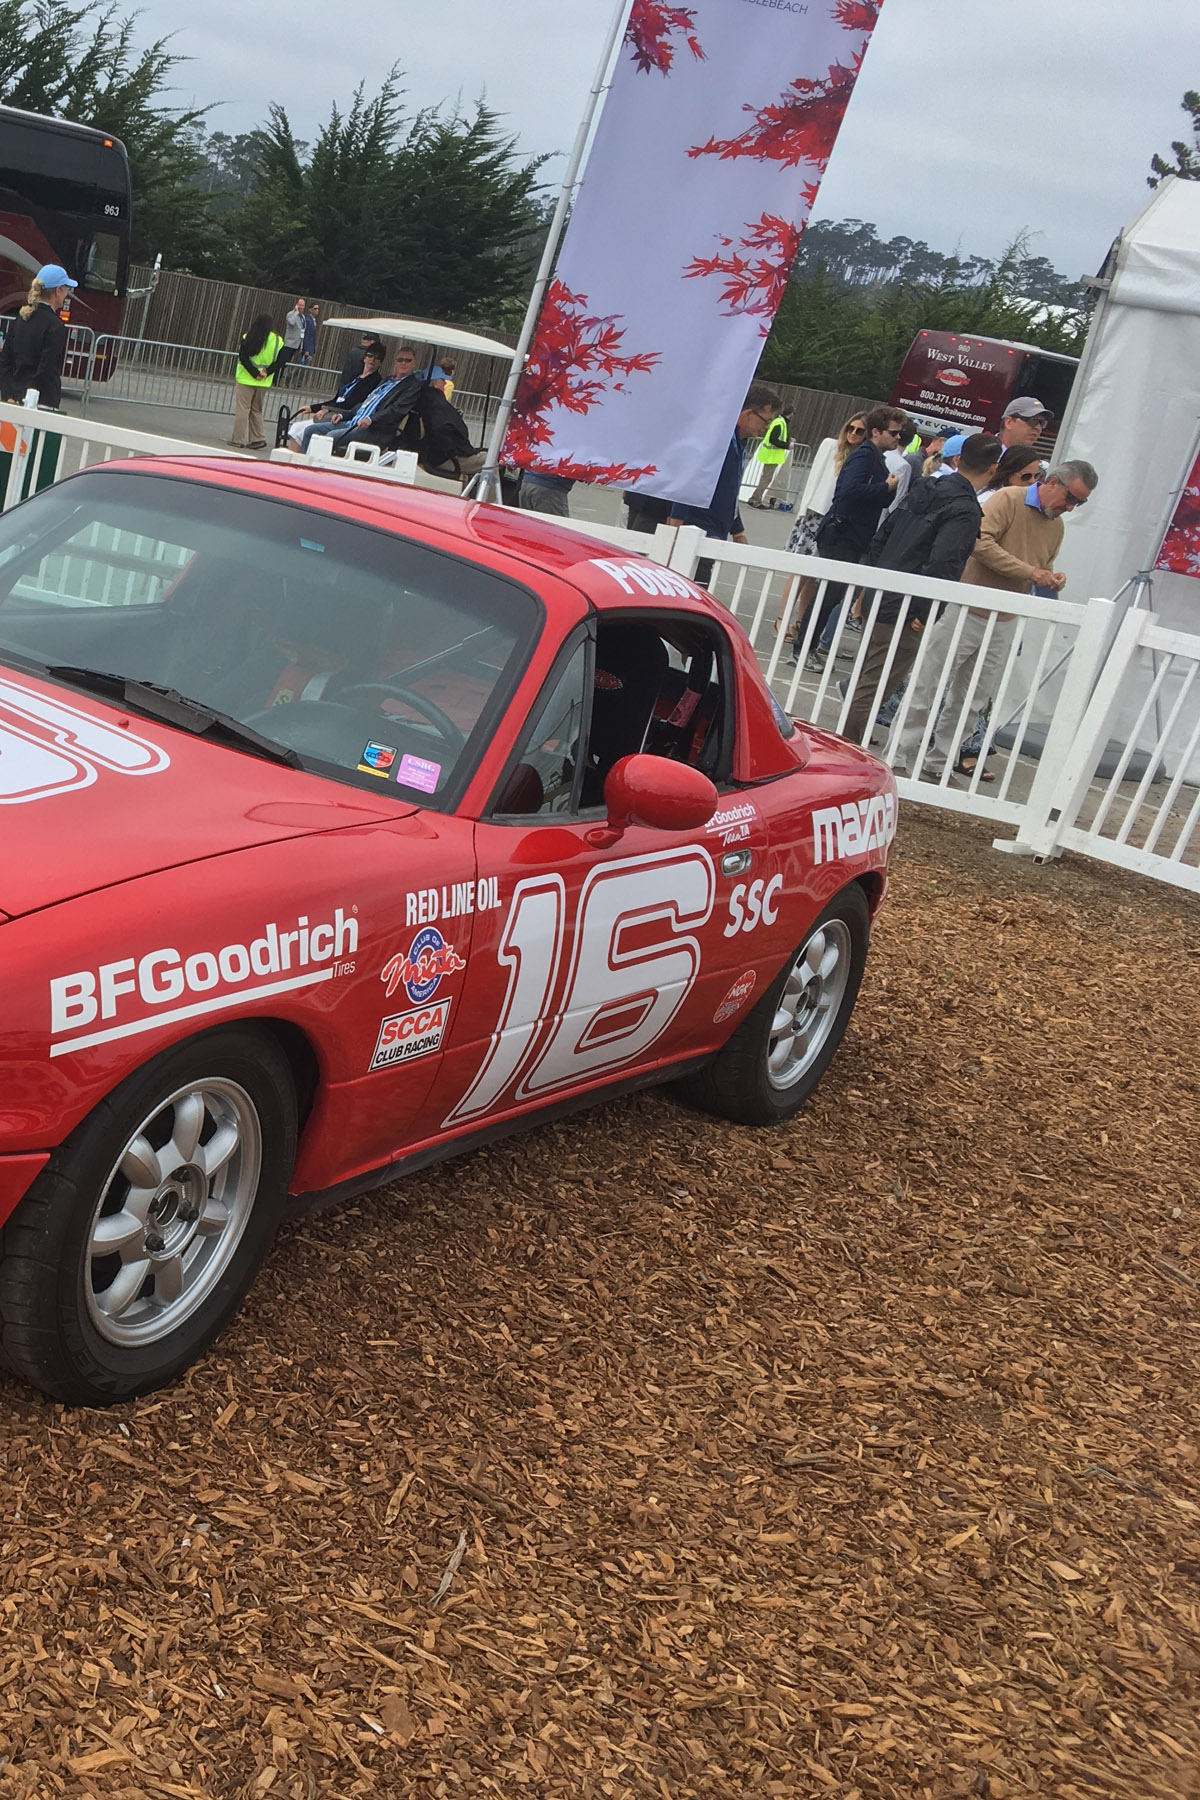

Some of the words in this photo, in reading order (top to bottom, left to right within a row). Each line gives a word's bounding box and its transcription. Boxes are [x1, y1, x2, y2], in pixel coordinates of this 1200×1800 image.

[104, 204, 120, 216] 963
[927, 348, 955, 363] WEST
[957, 354, 995, 372] VALLEY
[899, 397, 987, 423] www.WestValleyTrailways.com
[919, 390, 971, 409] 800.371.1230
[406, 888, 439, 926] RED
[441, 881, 475, 920] LINE
[477, 876, 502, 912] OIL
[723, 873, 783, 938] SSC
[413, 933, 431, 955] CLUB
[49, 908, 359, 1035] BFGoodrich
[332, 959, 356, 979] Tires
[410, 977, 438, 998] AMERICA
[440, 844, 716, 1129] 16
[381, 1007, 443, 1046] SCCA
[375, 1042, 404, 1064] CLUB
[404, 1033, 440, 1057] RACING
